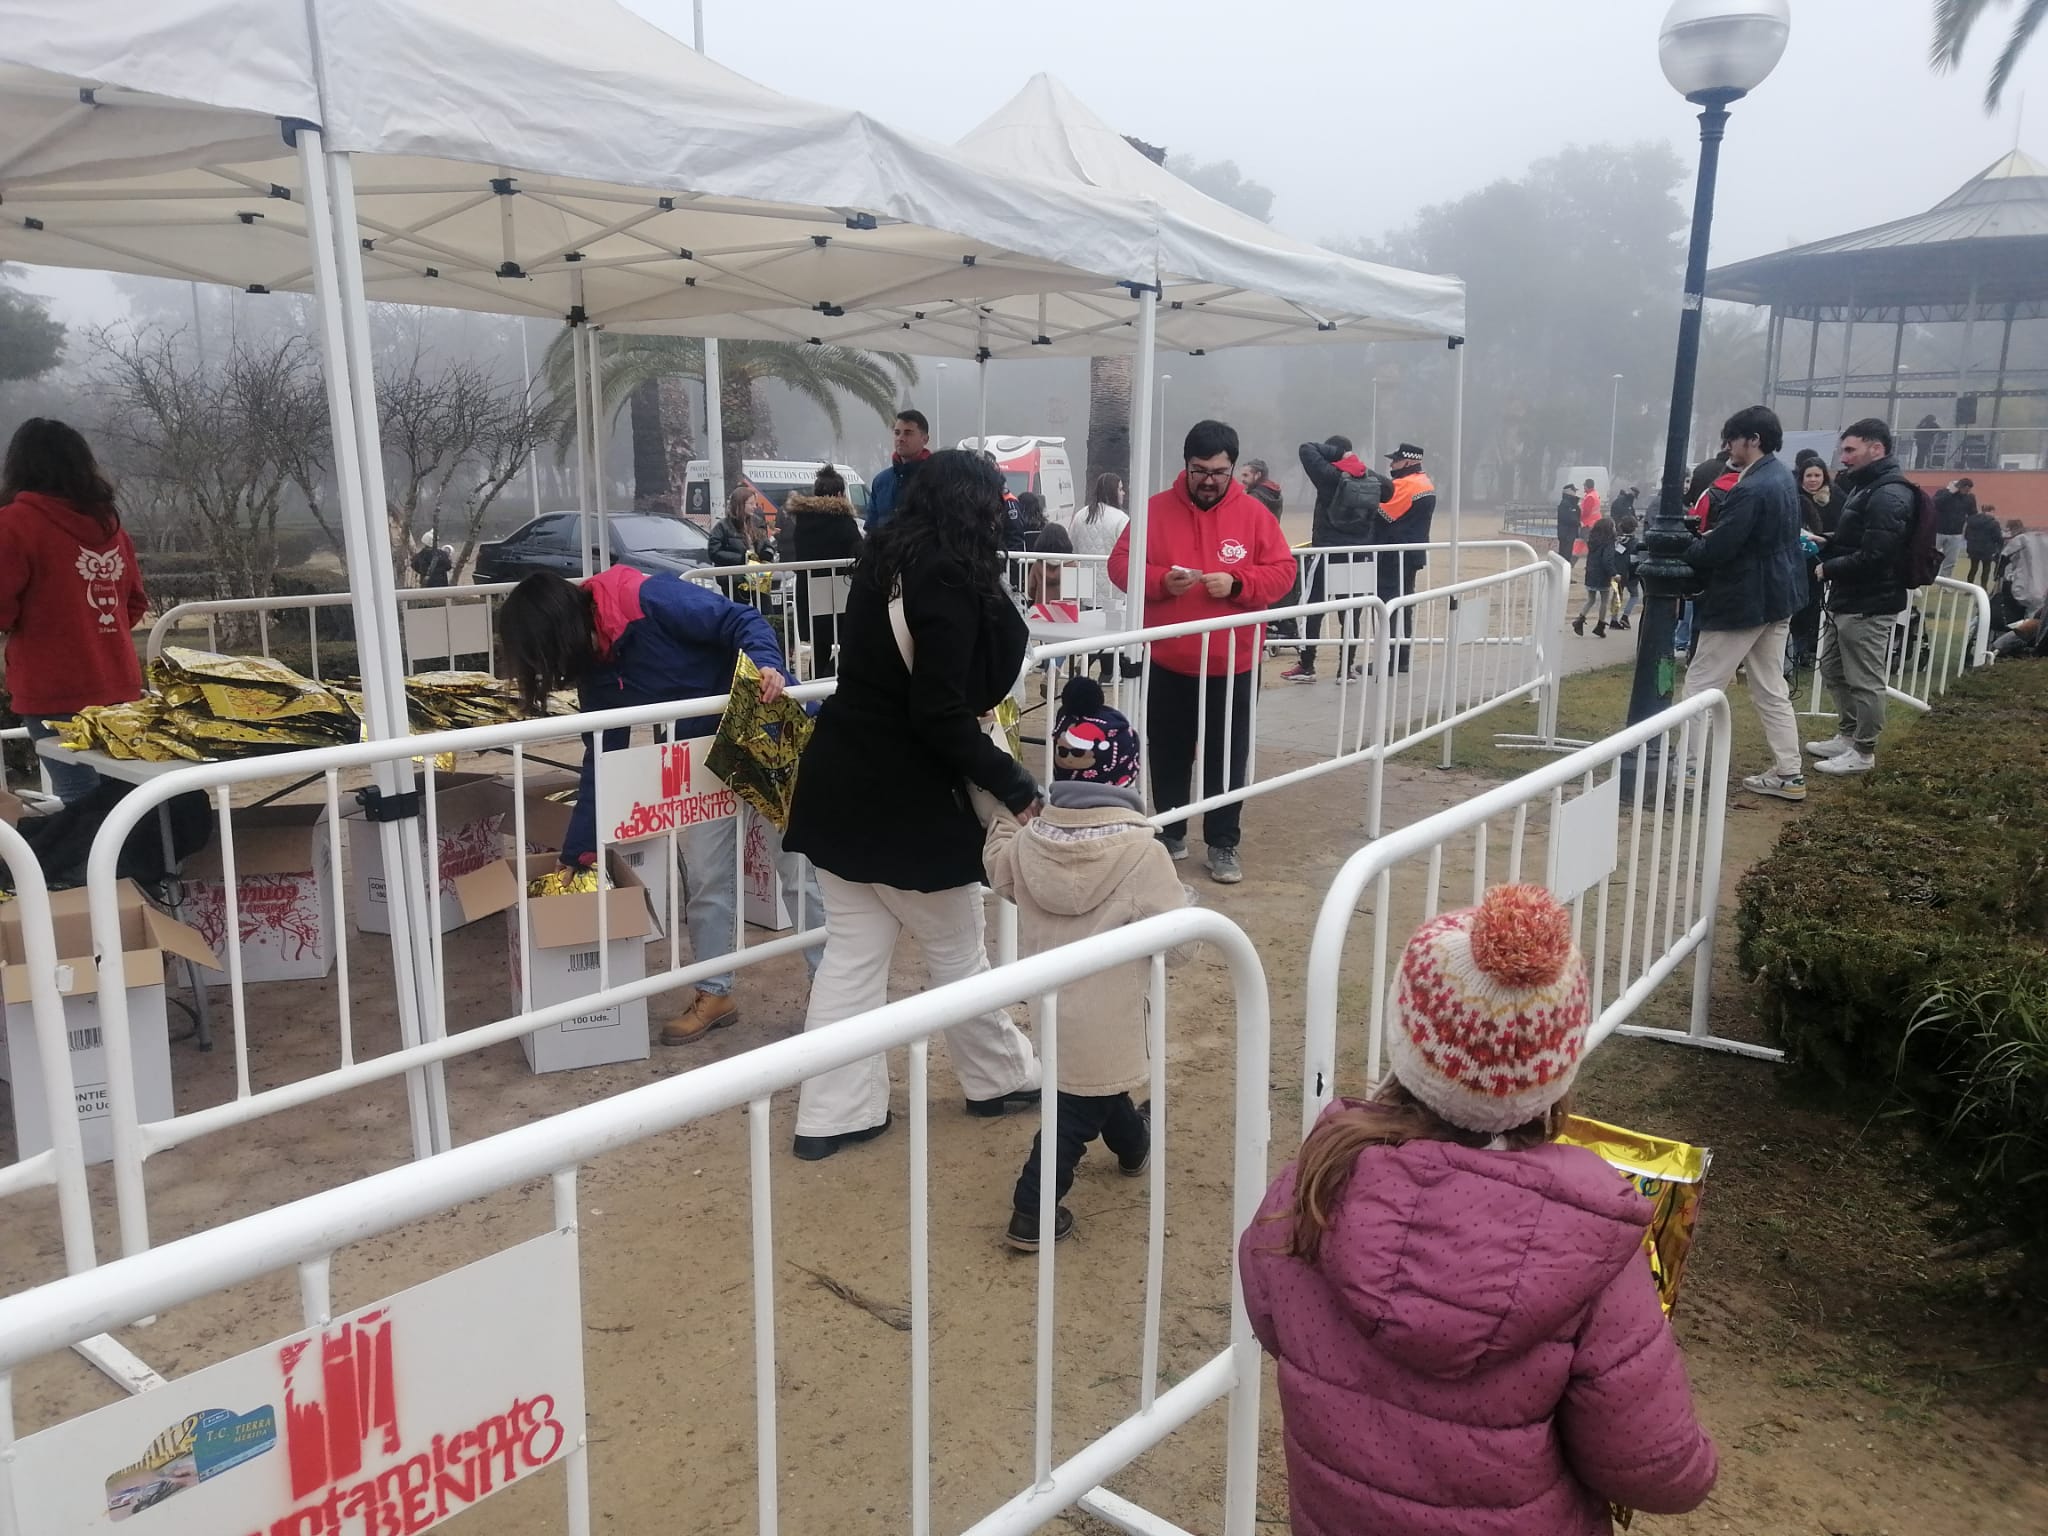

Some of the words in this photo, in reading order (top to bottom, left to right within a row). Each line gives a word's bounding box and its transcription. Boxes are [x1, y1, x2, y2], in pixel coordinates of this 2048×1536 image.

[680, 800, 737, 825] BENITO
[590, 1015, 610, 1023] Uds.
[234, 1417, 271, 1434] TIERRA
